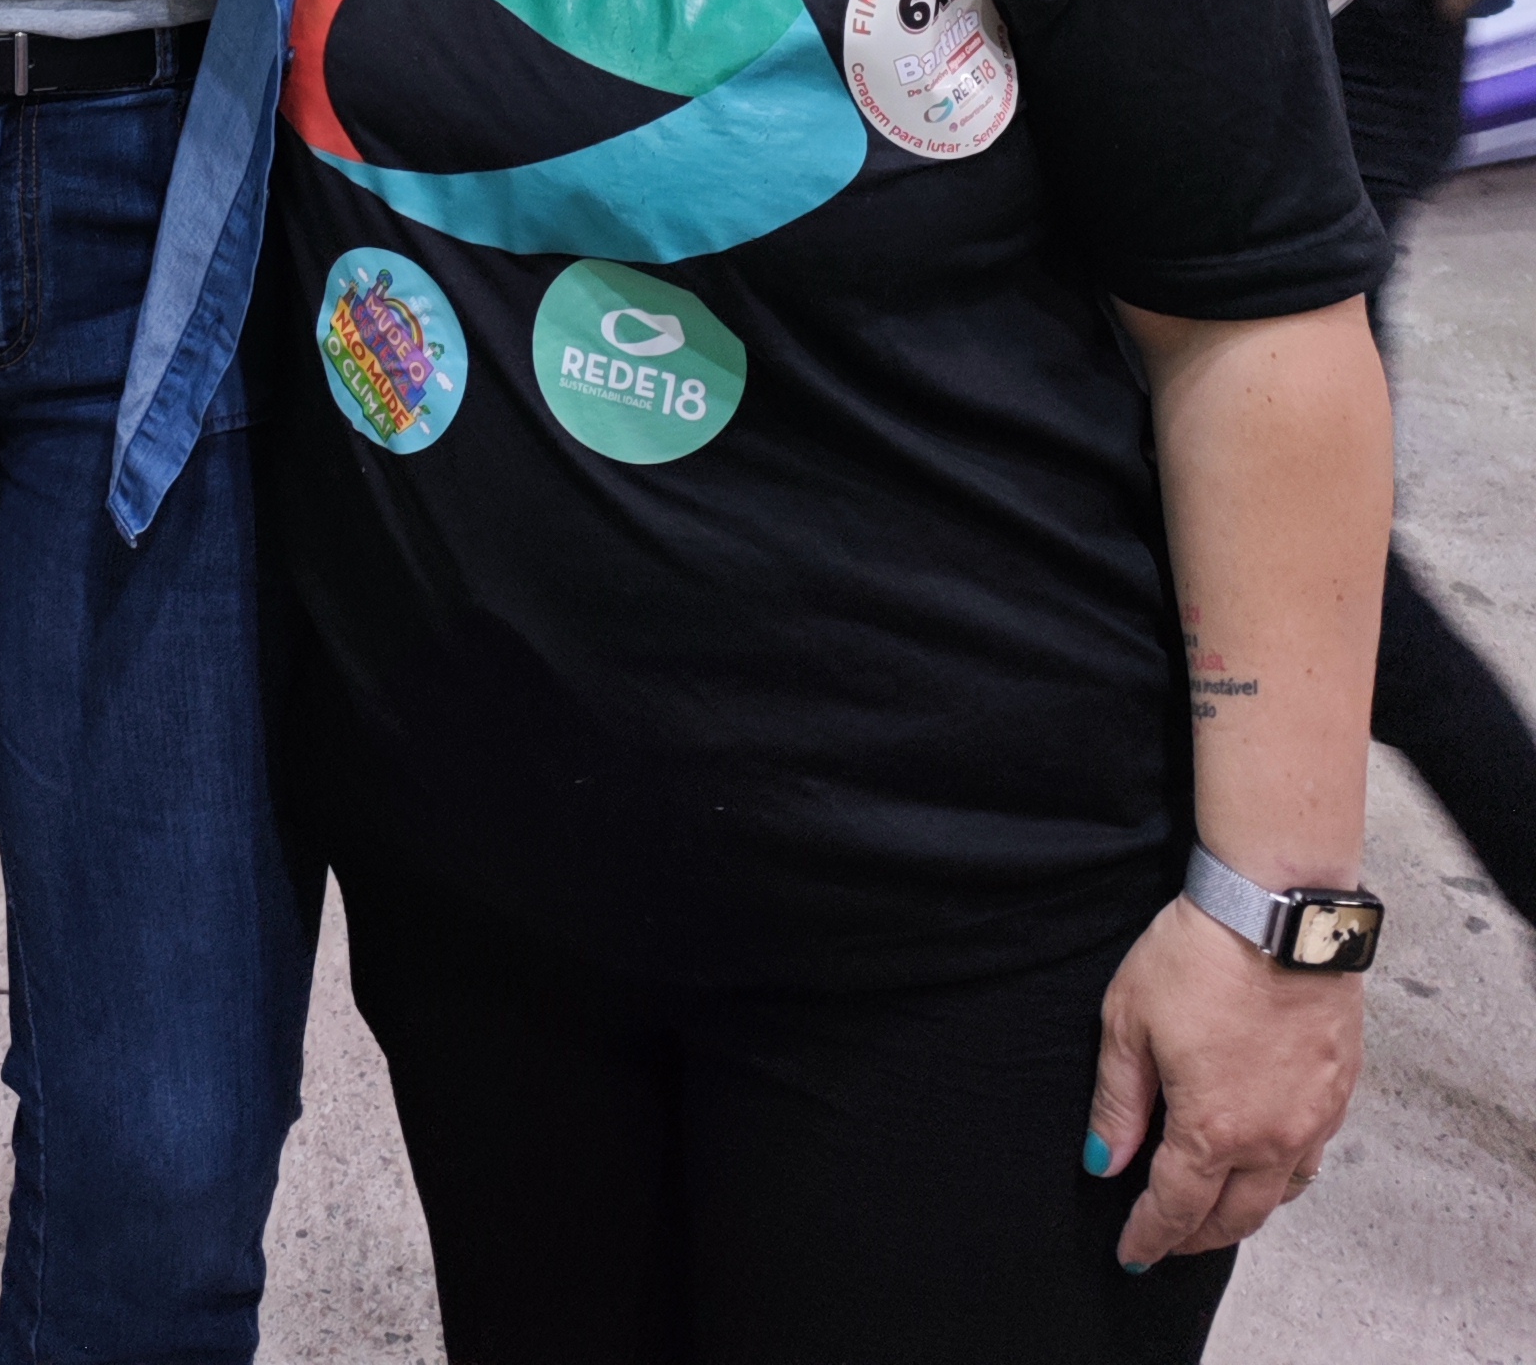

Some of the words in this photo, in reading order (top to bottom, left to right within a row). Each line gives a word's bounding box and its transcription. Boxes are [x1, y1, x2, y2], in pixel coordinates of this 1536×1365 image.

[893, 7, 981, 87] Bartiria
[951, 58, 997, 105] REDE18
[851, 62, 892, 129] Coragem
[889, 124, 924, 150] para
[925, 138, 962, 154] lutar
[365, 296, 412, 362] MUDE
[408, 361, 426, 382] O
[327, 336, 342, 357] O
[342, 358, 393, 435] CLIMA!
[366, 364, 410, 431] MUDE
[558, 376, 654, 412] SUSTENTABILIDADE
[560, 345, 707, 421] REDE18
